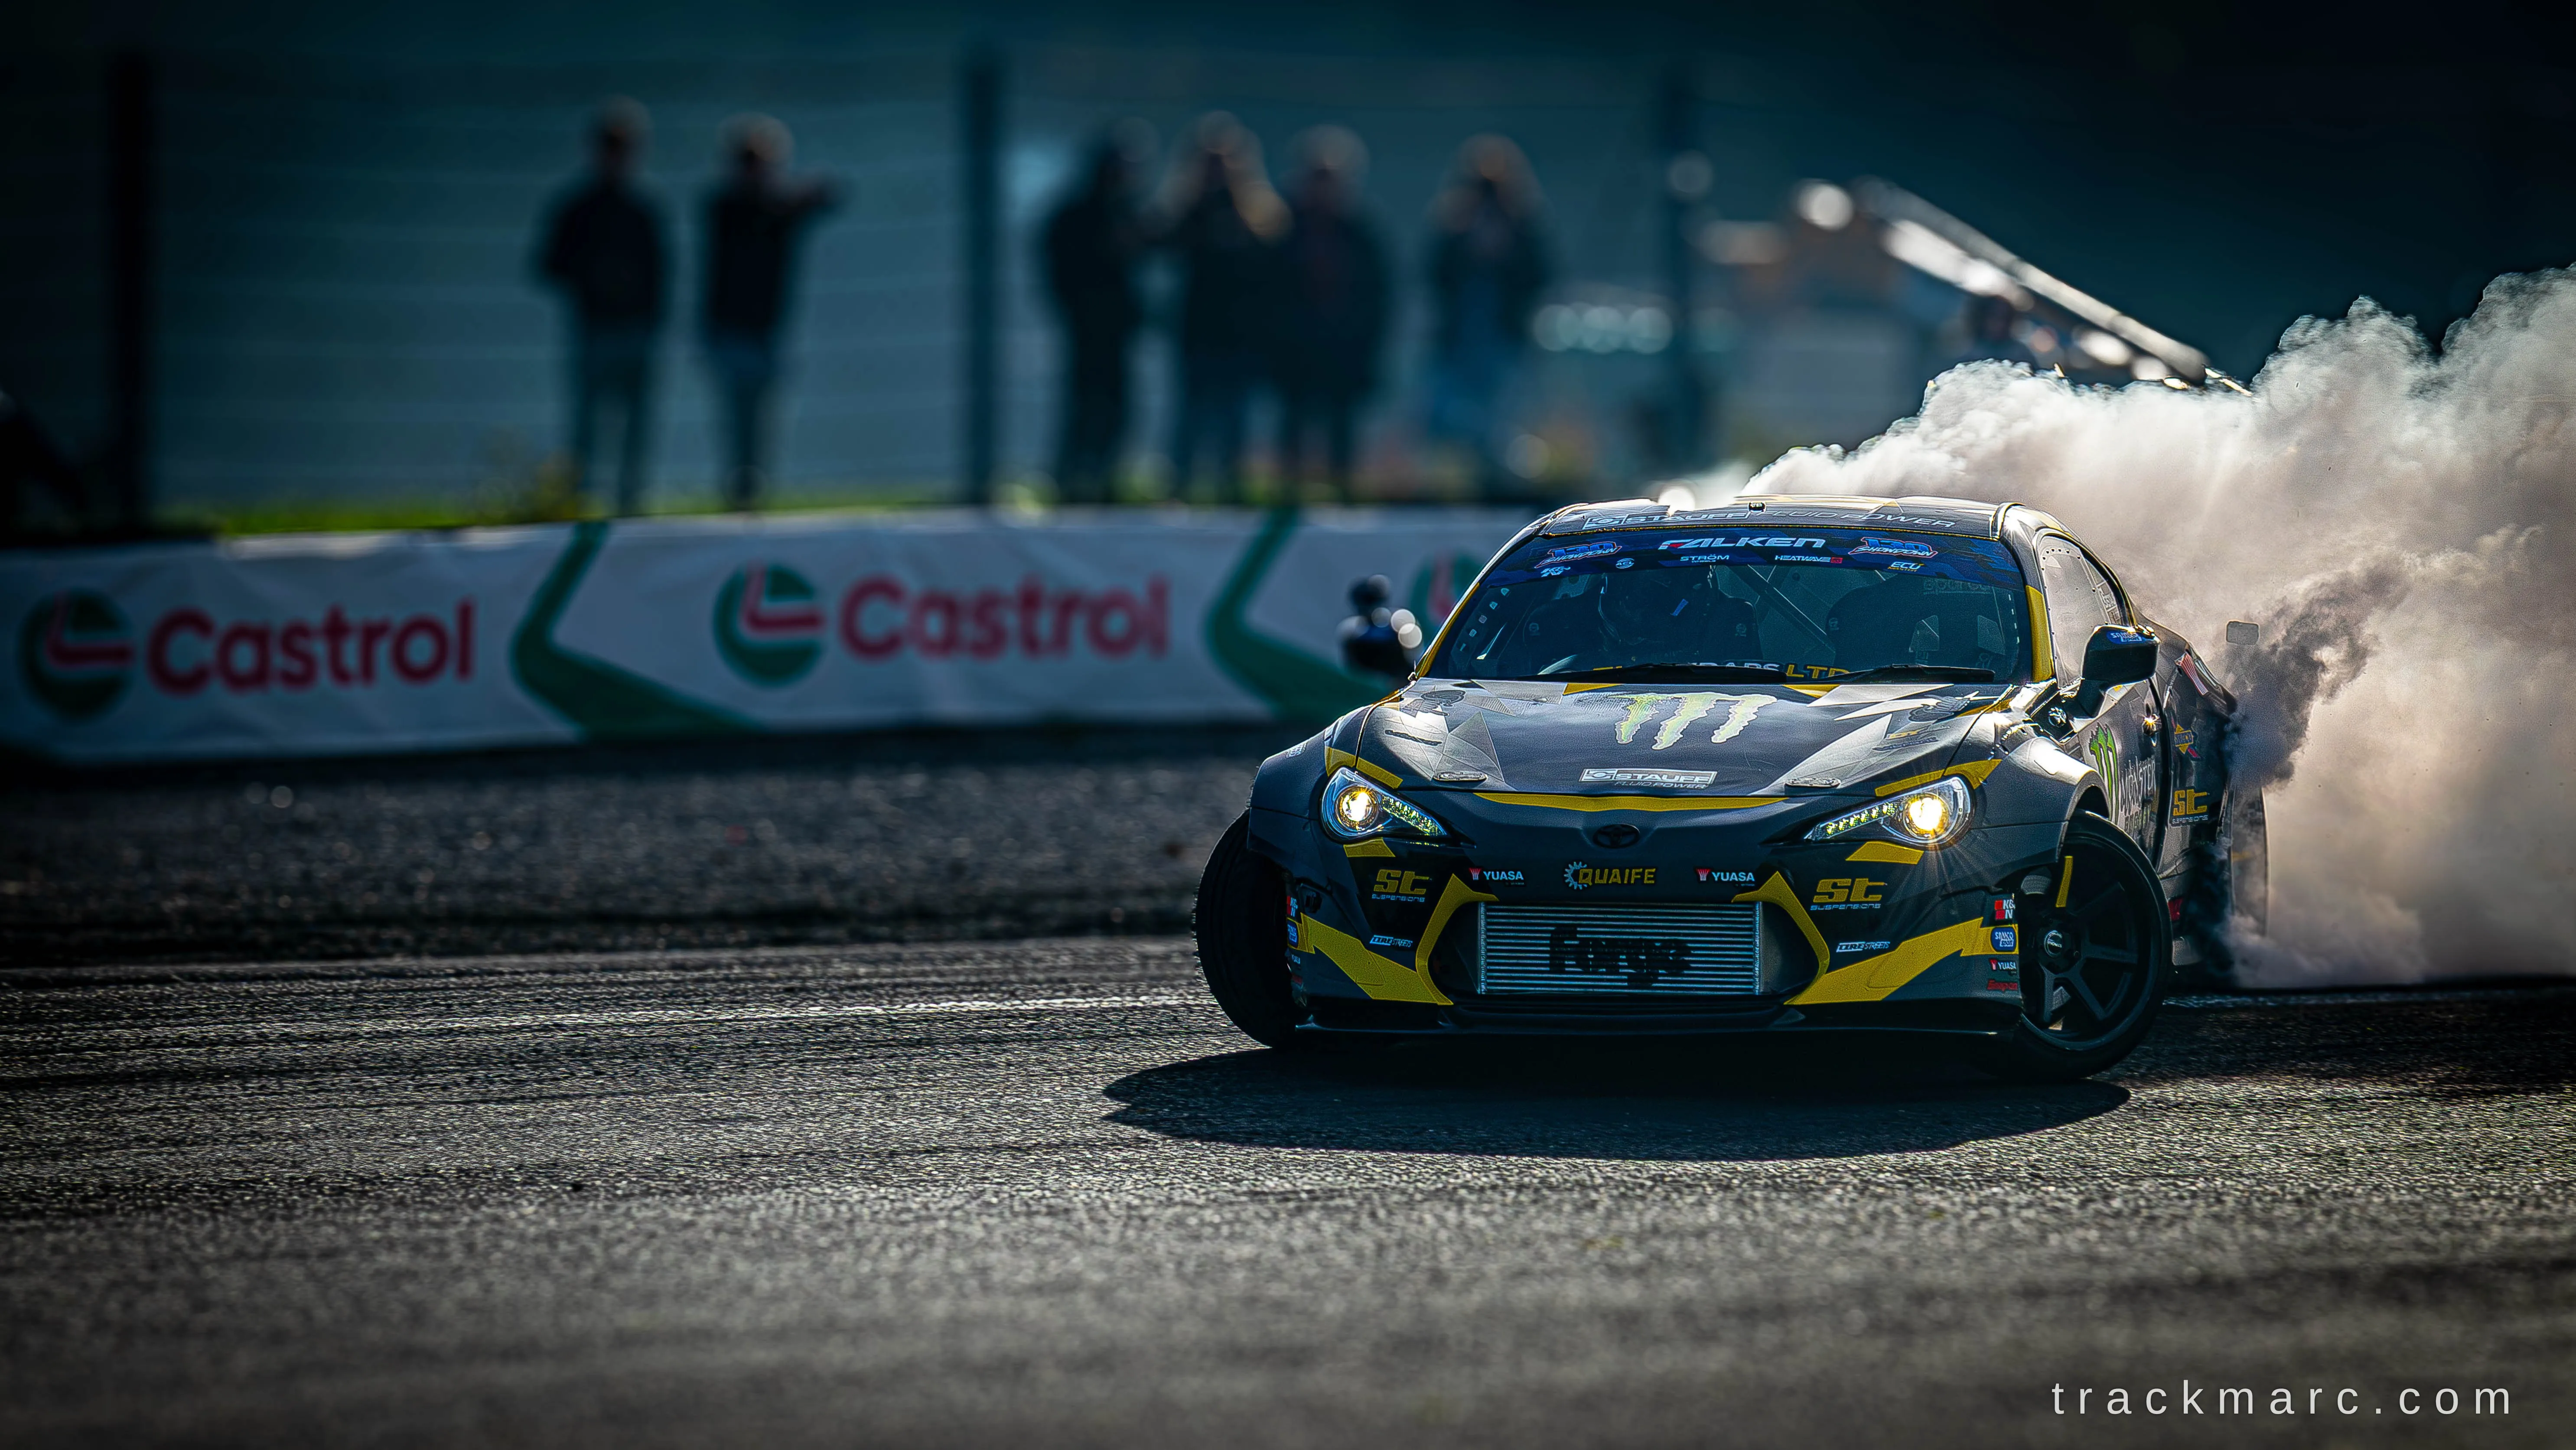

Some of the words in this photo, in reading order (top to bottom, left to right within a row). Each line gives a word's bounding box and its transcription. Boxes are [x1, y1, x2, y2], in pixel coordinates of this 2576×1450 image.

[1625, 512, 1748, 523] STAUFF
[1840, 513, 1956, 528] POWER
[1658, 537, 1826, 550] FALKEN
[1865, 538, 1930, 551] 130
[1541, 547, 1618, 564] SHOWDOWN
[1854, 546, 1933, 556] SHOWDOWN
[1890, 561, 1921, 570] ECU
[838, 578, 1169, 662] Castrol
[146, 598, 475, 696] Castrol
[1615, 773, 1710, 783] STAUFF
[1483, 870, 1524, 880] YUASA
[1578, 868, 1656, 886] QUAIFE
[1711, 871, 1755, 881] YUASA
[1371, 893, 1426, 903] SUSPENSIONS
[1549, 926, 1691, 988] Forge
[1998, 961, 2016, 970] YUASA
